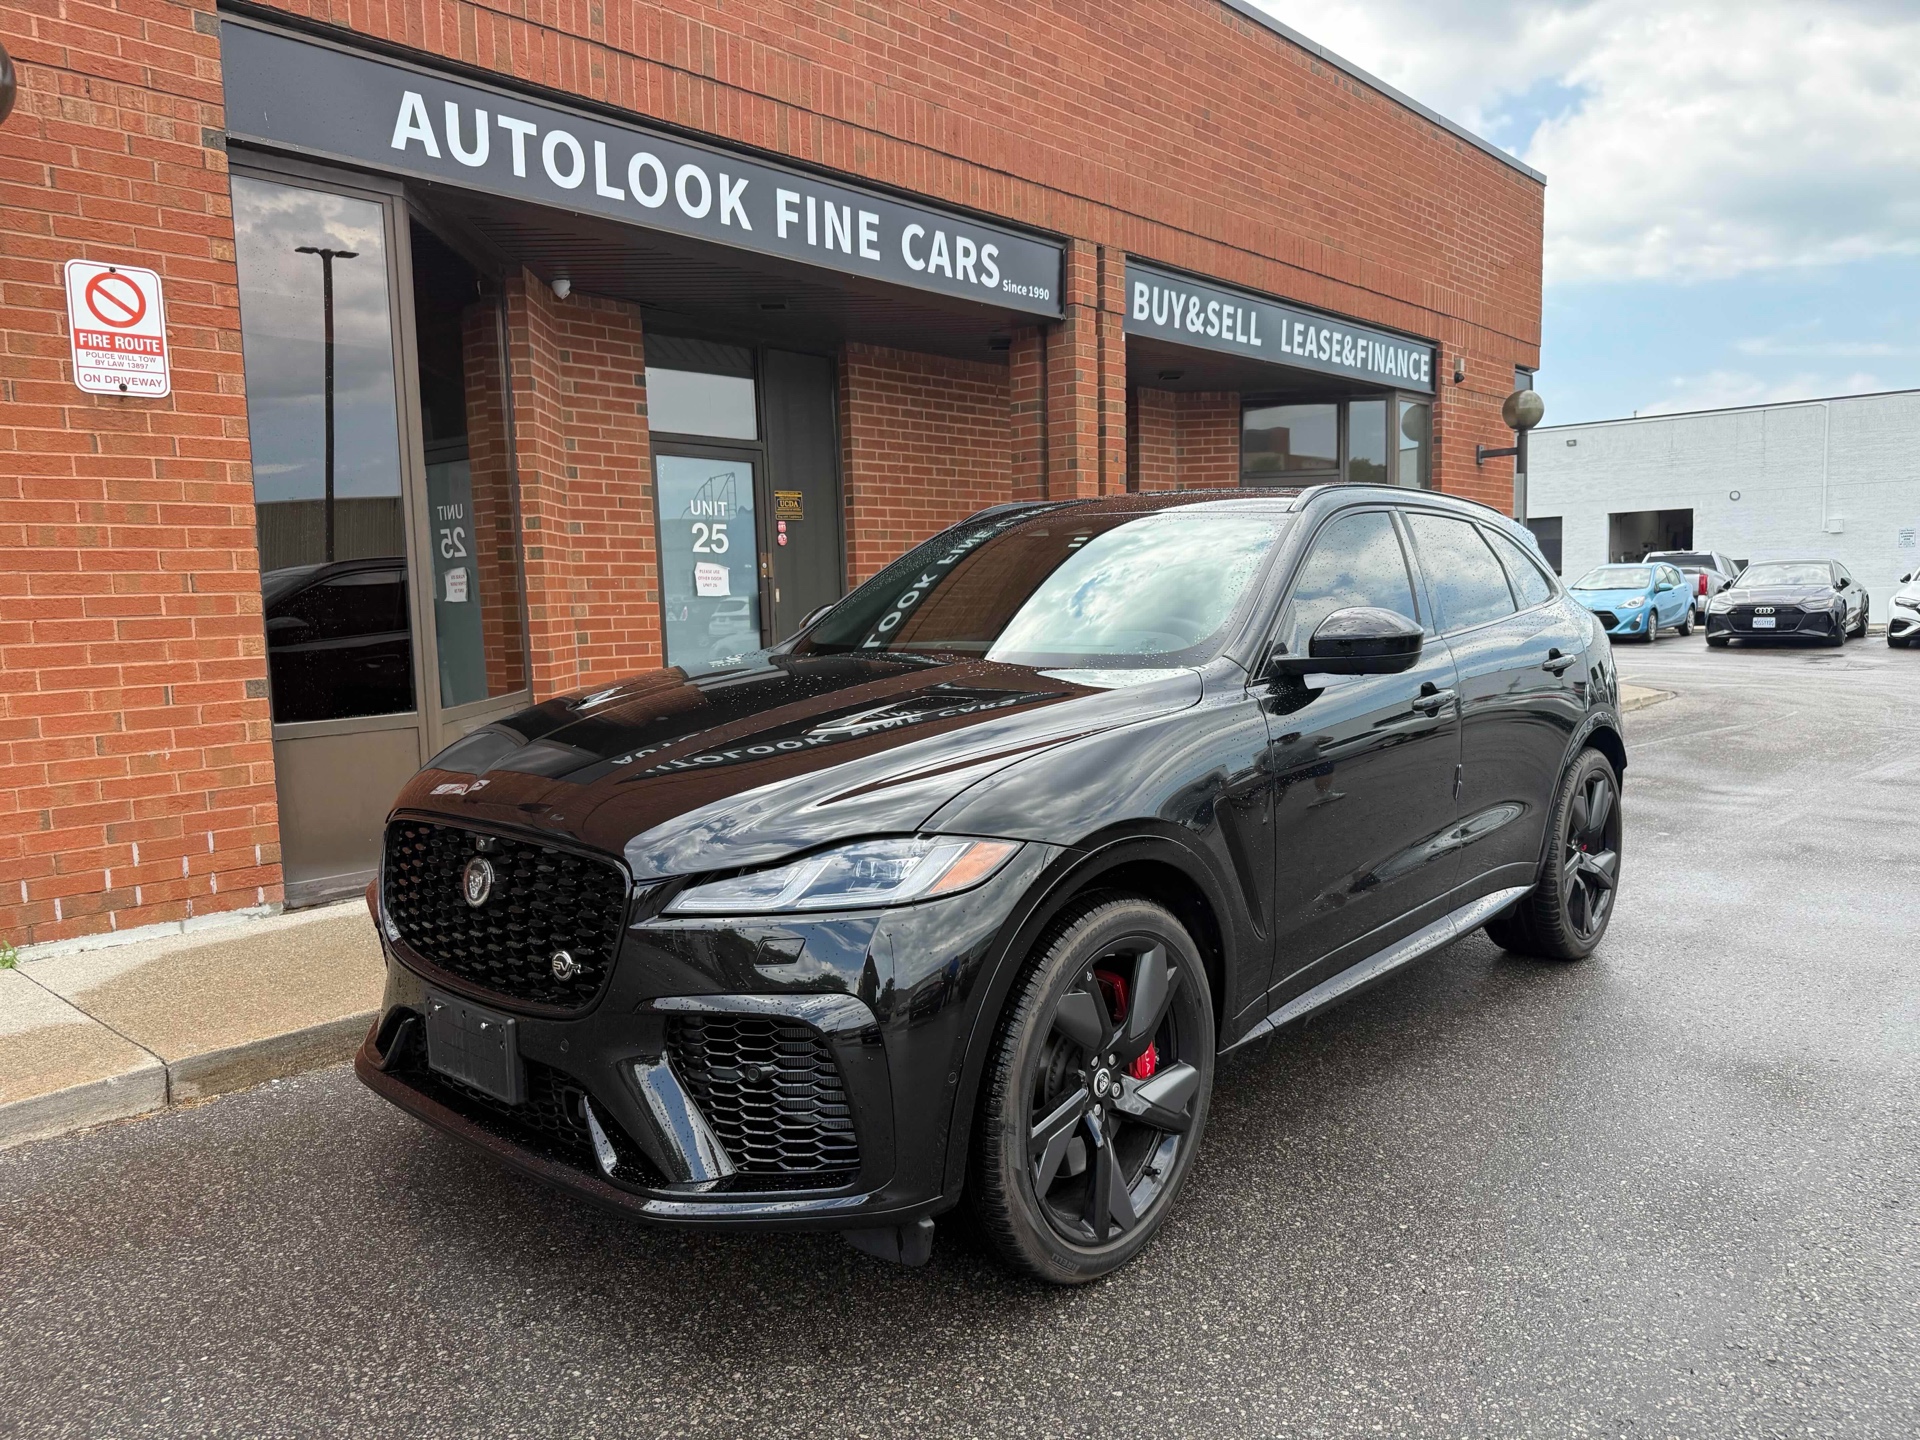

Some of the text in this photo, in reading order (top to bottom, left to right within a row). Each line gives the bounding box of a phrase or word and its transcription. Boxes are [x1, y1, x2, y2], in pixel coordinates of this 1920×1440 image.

[391, 90, 1000, 288] AUTOLOOK FINE CARS
[1002, 279, 1050, 301] Since 1990
[1132, 281, 1430, 382] BUY&SELL LEASE&FINANCE
[79, 332, 161, 352] FIRE ROUTE
[85, 351, 157, 363] POLICE WILL TOW
[108, 360, 125, 368] LAW
[83, 373, 163, 388] ON DRIVEWAY
[690, 500, 727, 516] UNIT
[779, 500, 799, 508] UCDA
[691, 522, 729, 554] 25
